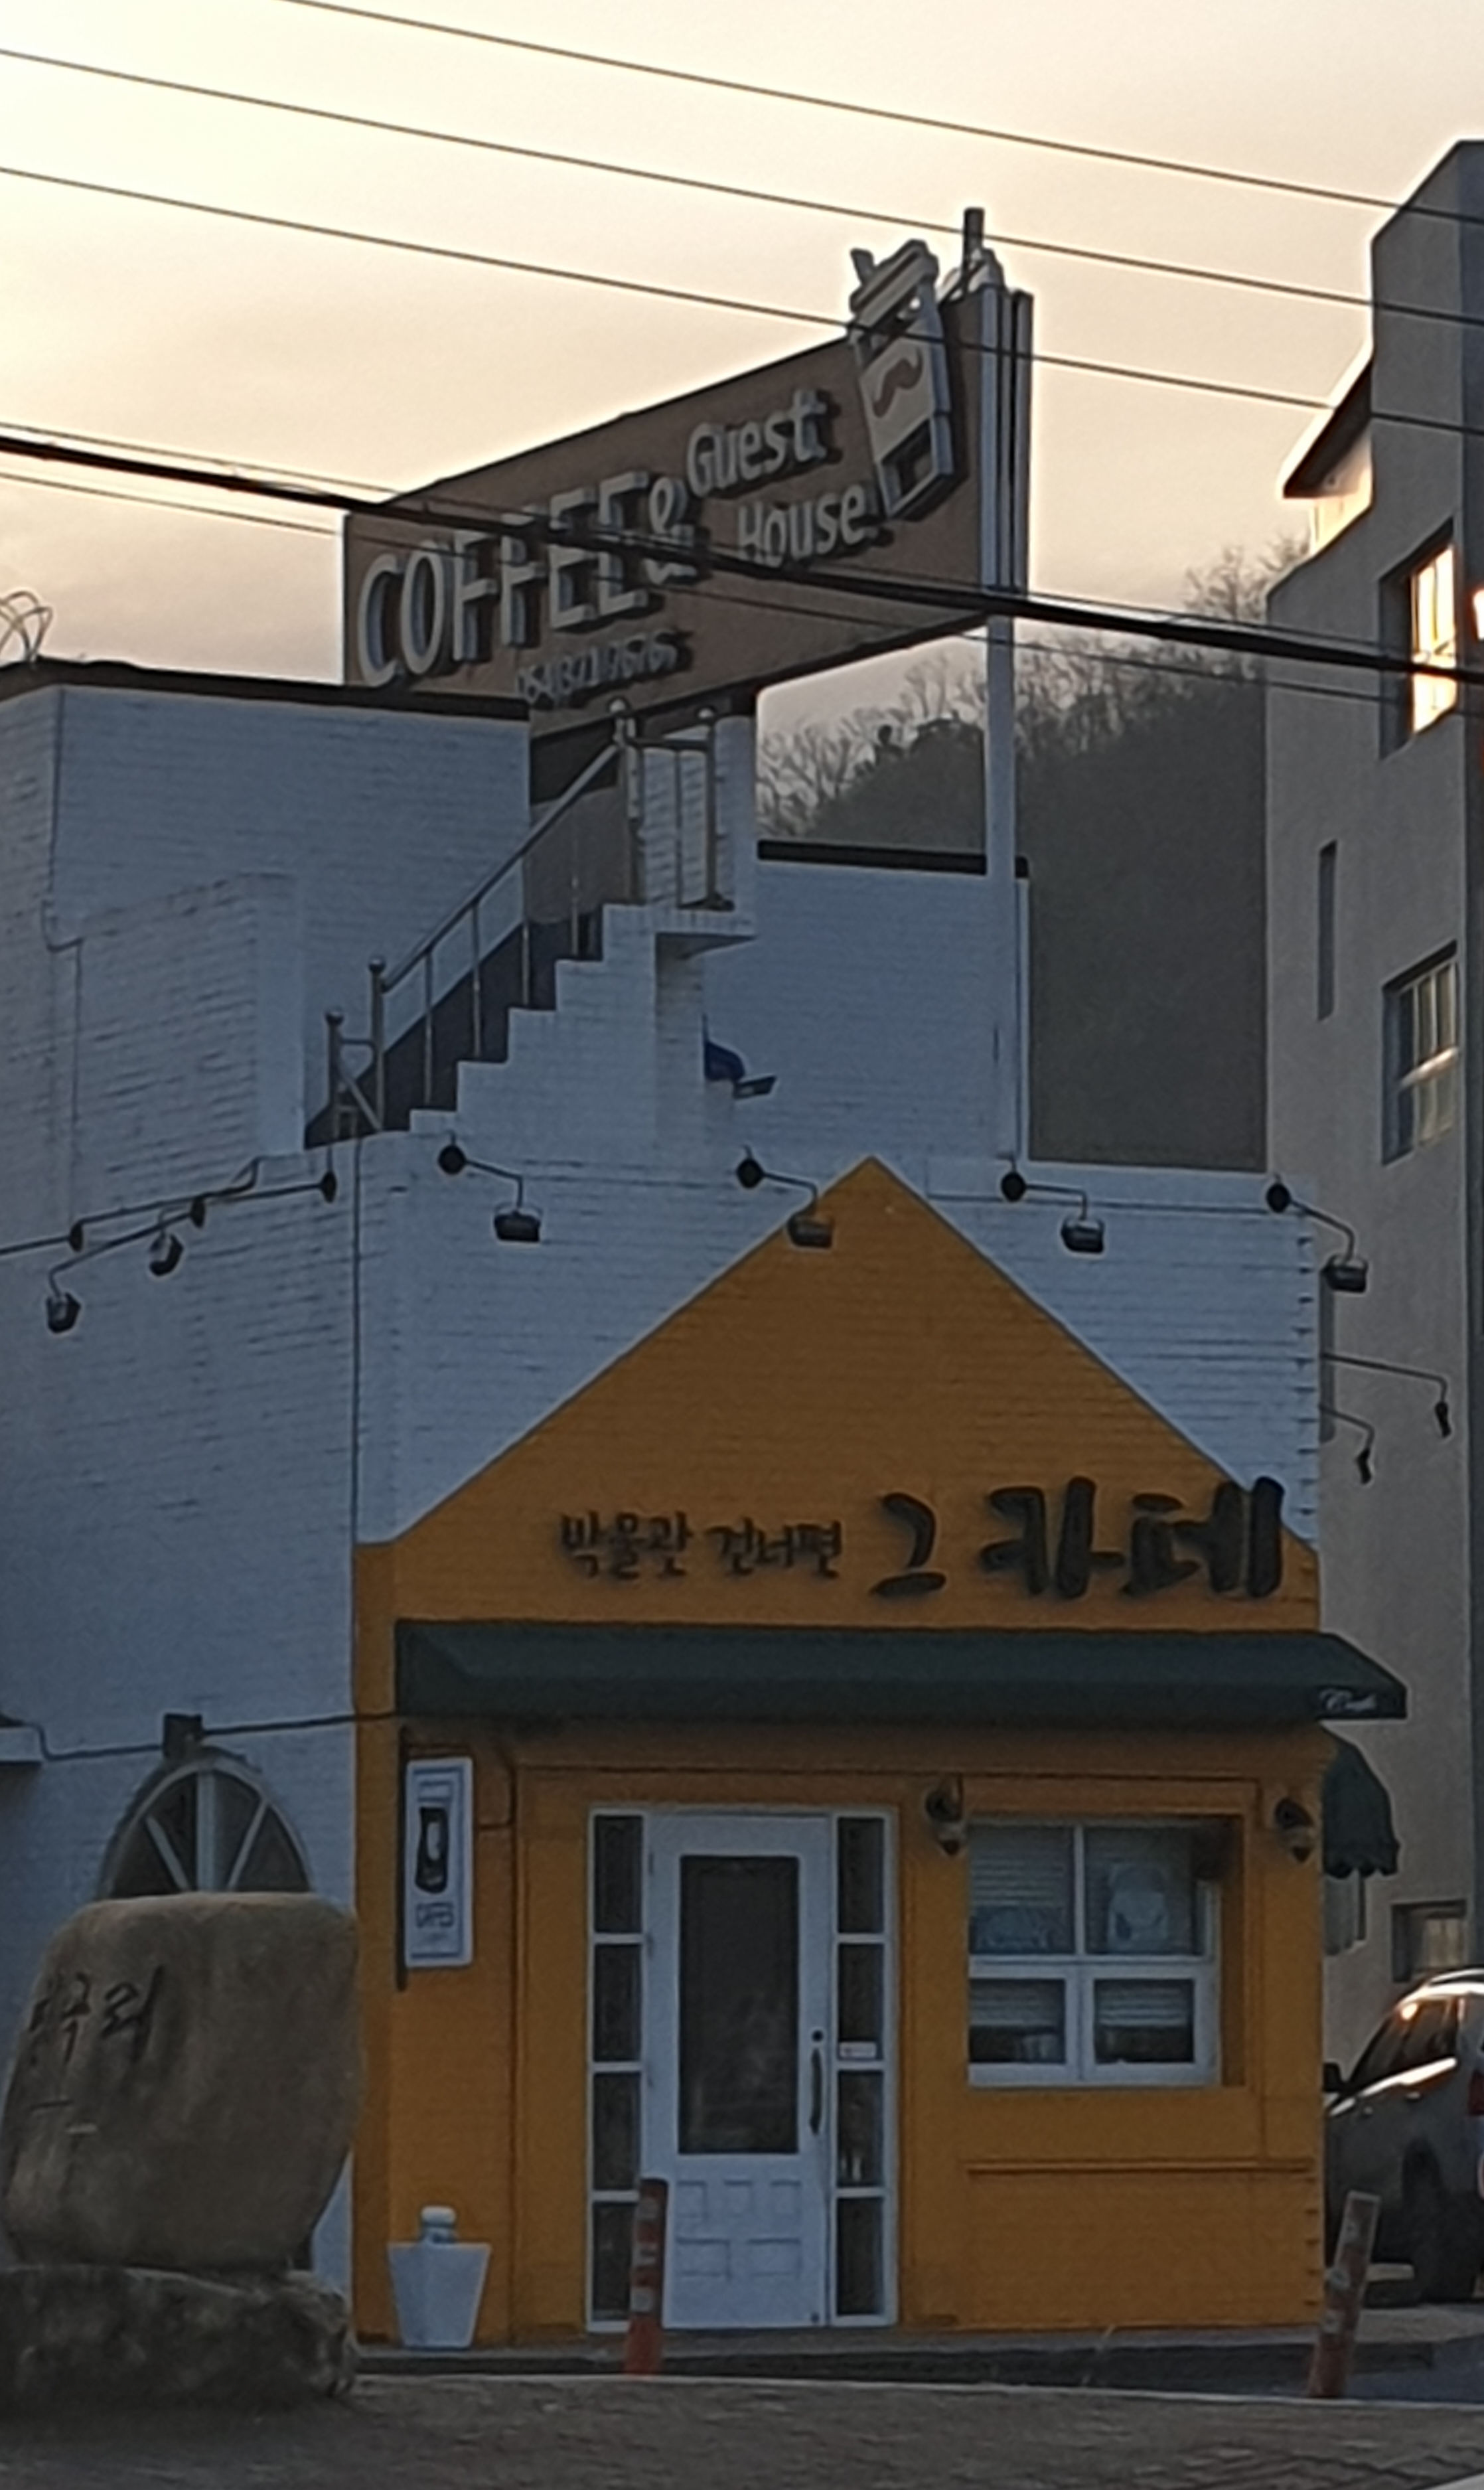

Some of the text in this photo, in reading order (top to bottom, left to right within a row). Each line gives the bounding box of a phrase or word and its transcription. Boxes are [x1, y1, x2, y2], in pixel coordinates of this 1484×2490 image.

[687, 388, 828, 497] Guest
[358, 471, 649, 688] COFFEE
[559, 1510, 693, 1581] 박물관
[705, 1517, 843, 1580] 건너편
